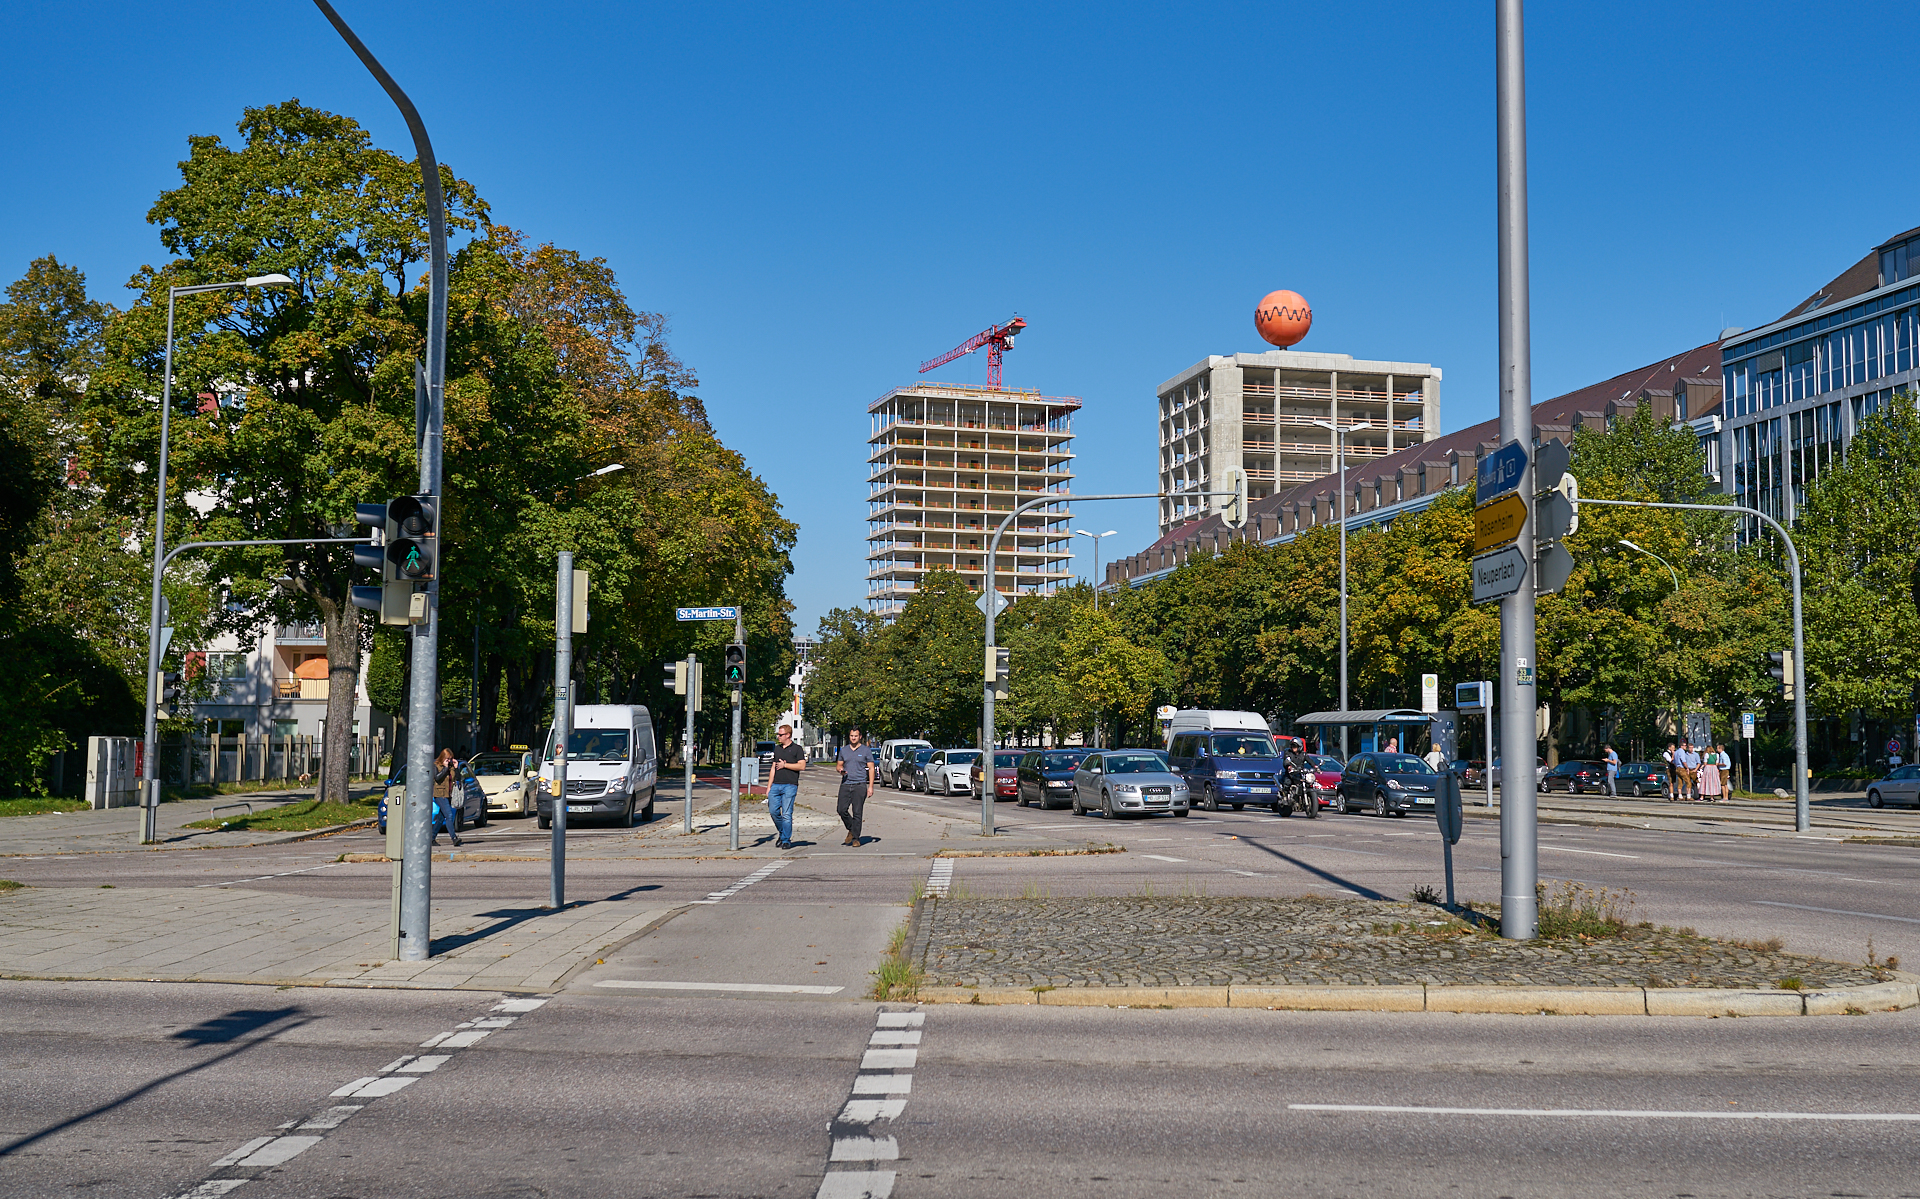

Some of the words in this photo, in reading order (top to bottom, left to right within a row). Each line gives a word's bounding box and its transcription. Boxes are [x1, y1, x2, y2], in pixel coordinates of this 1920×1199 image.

[1480, 511, 1514, 539] Rosenheim
[1477, 558, 1515, 589] Neuperlach
[679, 608, 735, 619] St.-Martin-Str.
